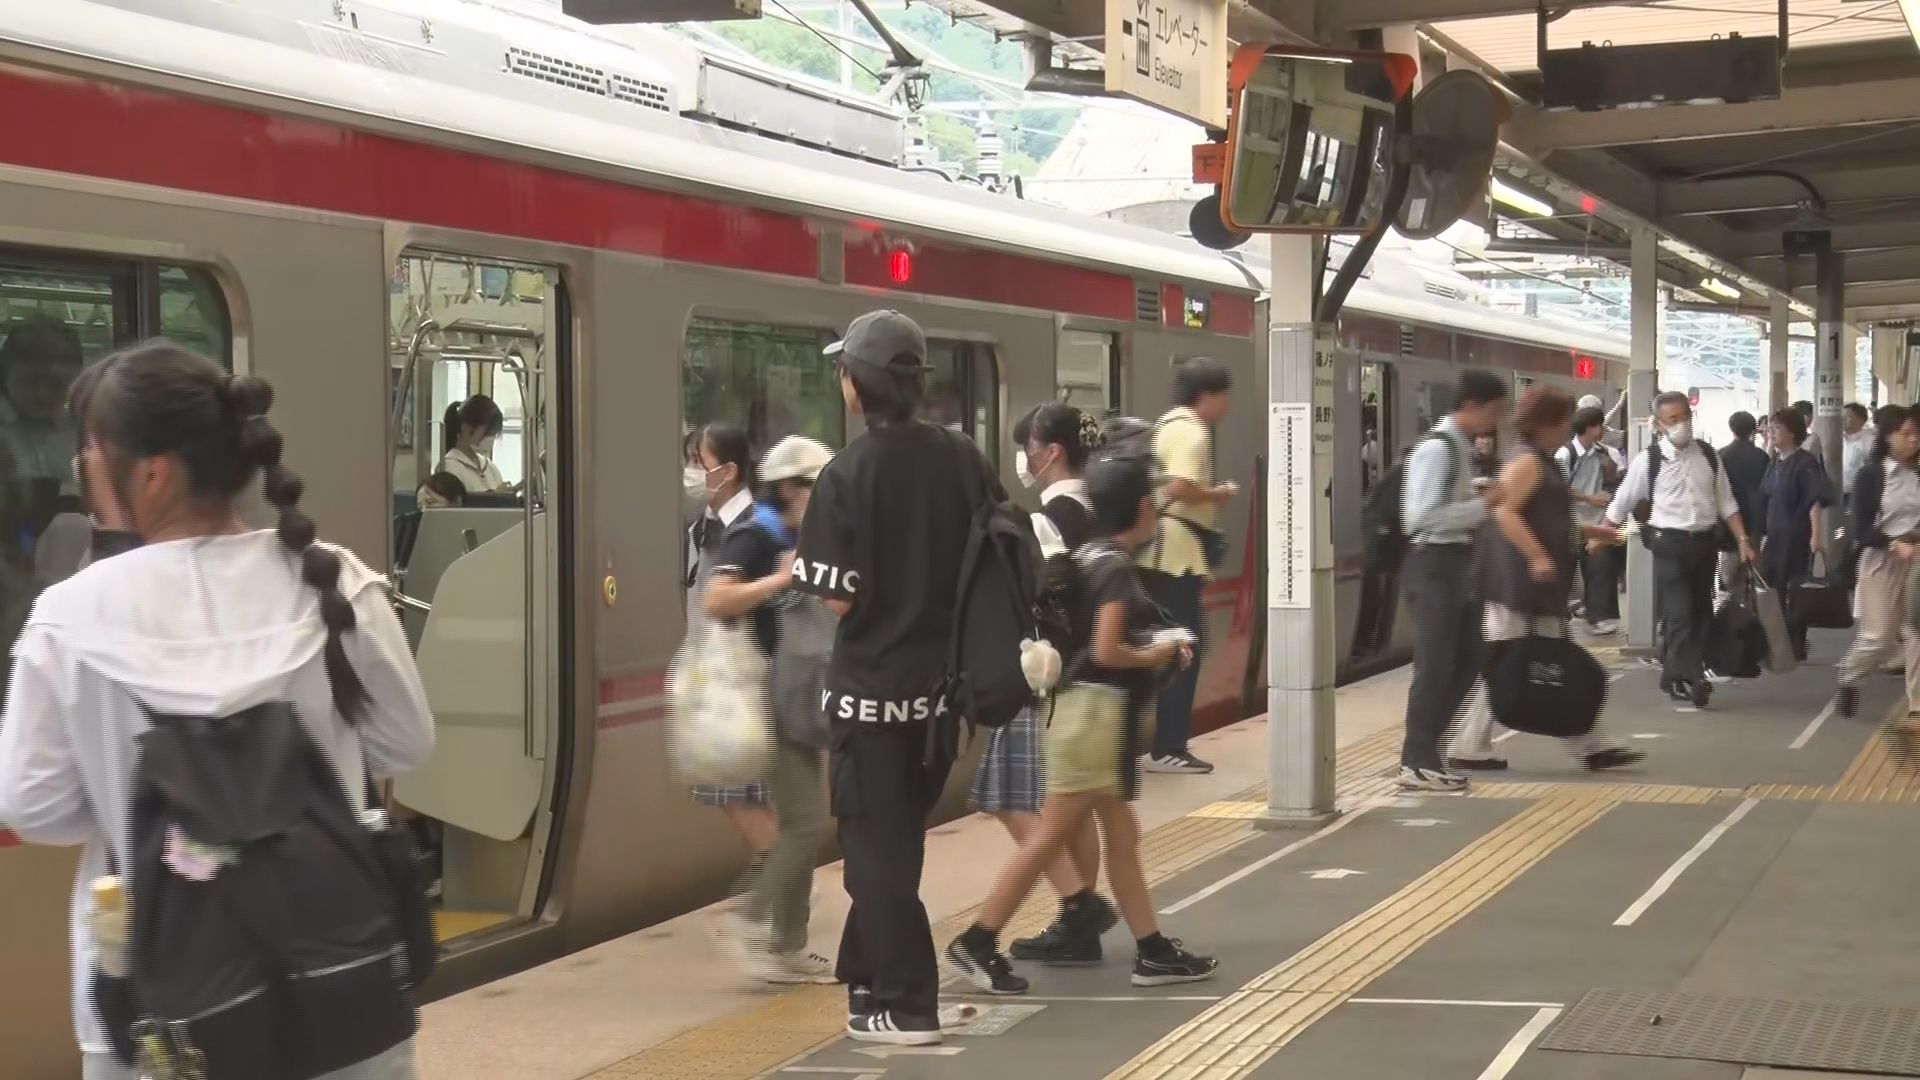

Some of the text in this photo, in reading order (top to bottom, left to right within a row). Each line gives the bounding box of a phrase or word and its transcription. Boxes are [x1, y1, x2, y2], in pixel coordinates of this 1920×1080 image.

[1155, 7, 1208, 56] エレベーター
[1155, 57, 1183, 90] Elevator
[1829, 331, 1839, 360] 1
